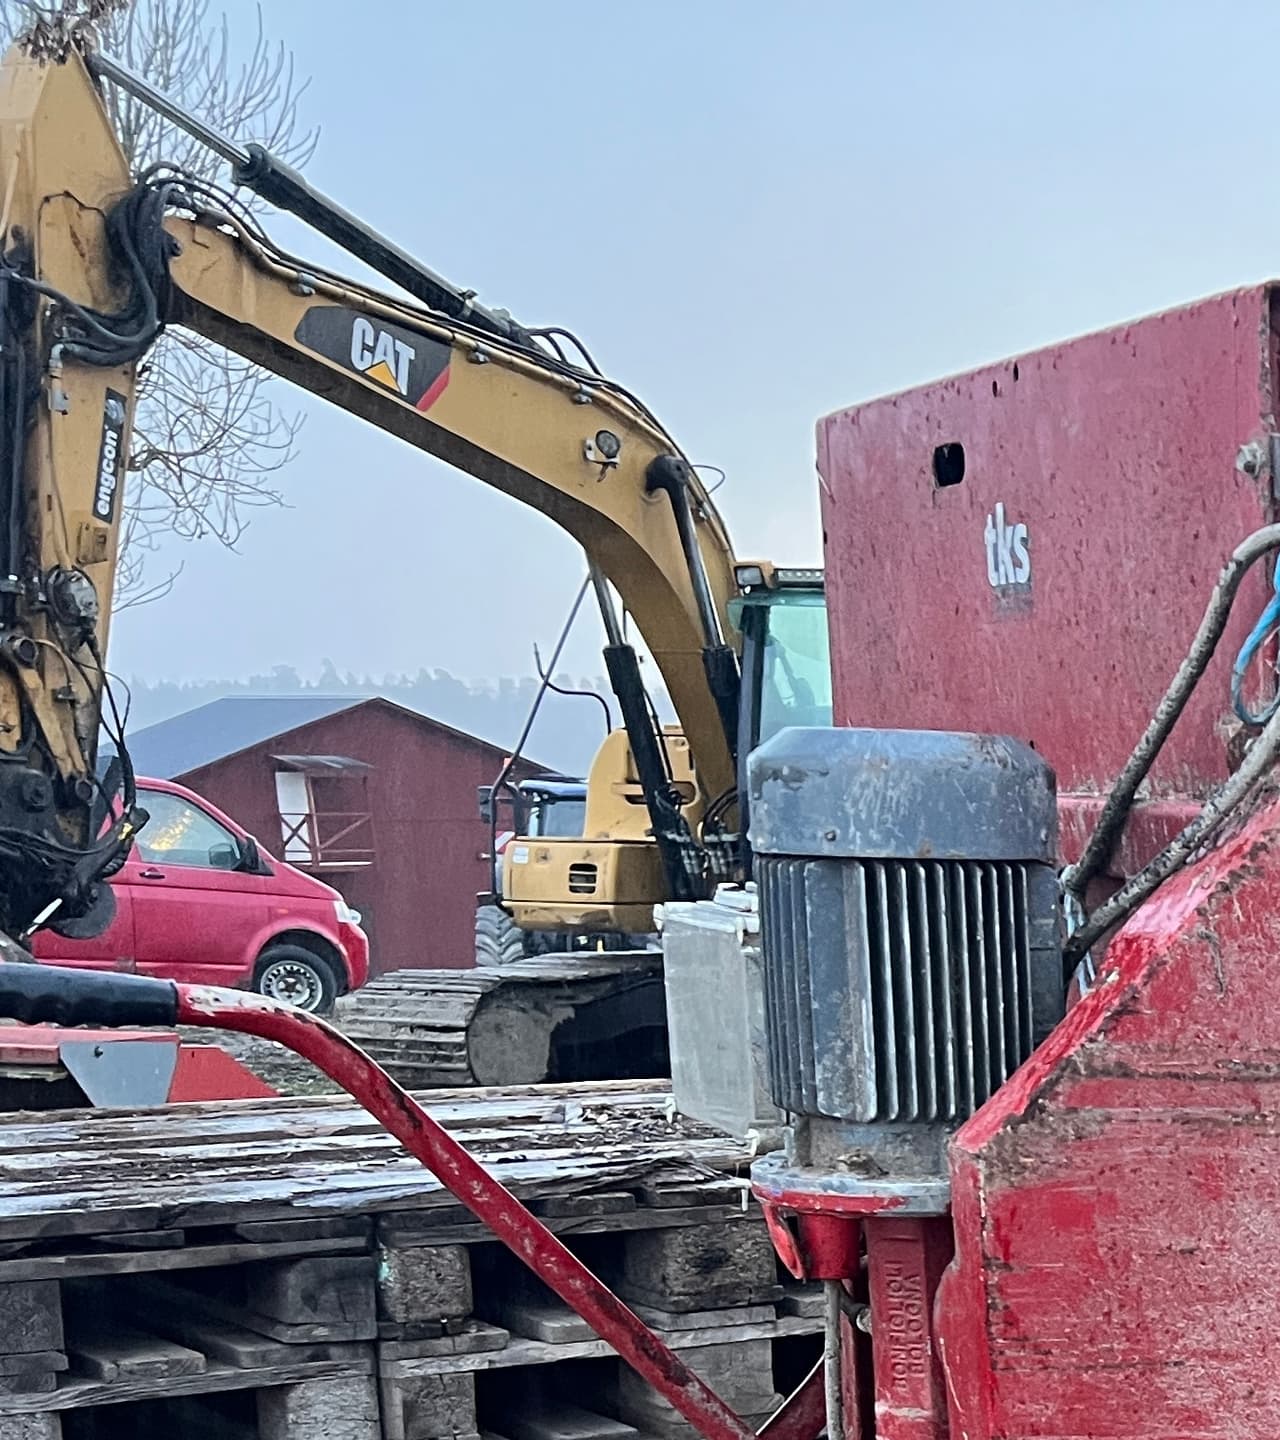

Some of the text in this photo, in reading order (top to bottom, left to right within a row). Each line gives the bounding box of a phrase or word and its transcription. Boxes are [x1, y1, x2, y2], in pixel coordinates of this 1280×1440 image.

[351, 317, 415, 396] CAT
[96, 429, 118, 516] engcon
[984, 502, 1030, 587] tks
[884, 1260, 908, 1394] BONFIGLIOLI
[903, 1273, 926, 1378] BOLOGNA
